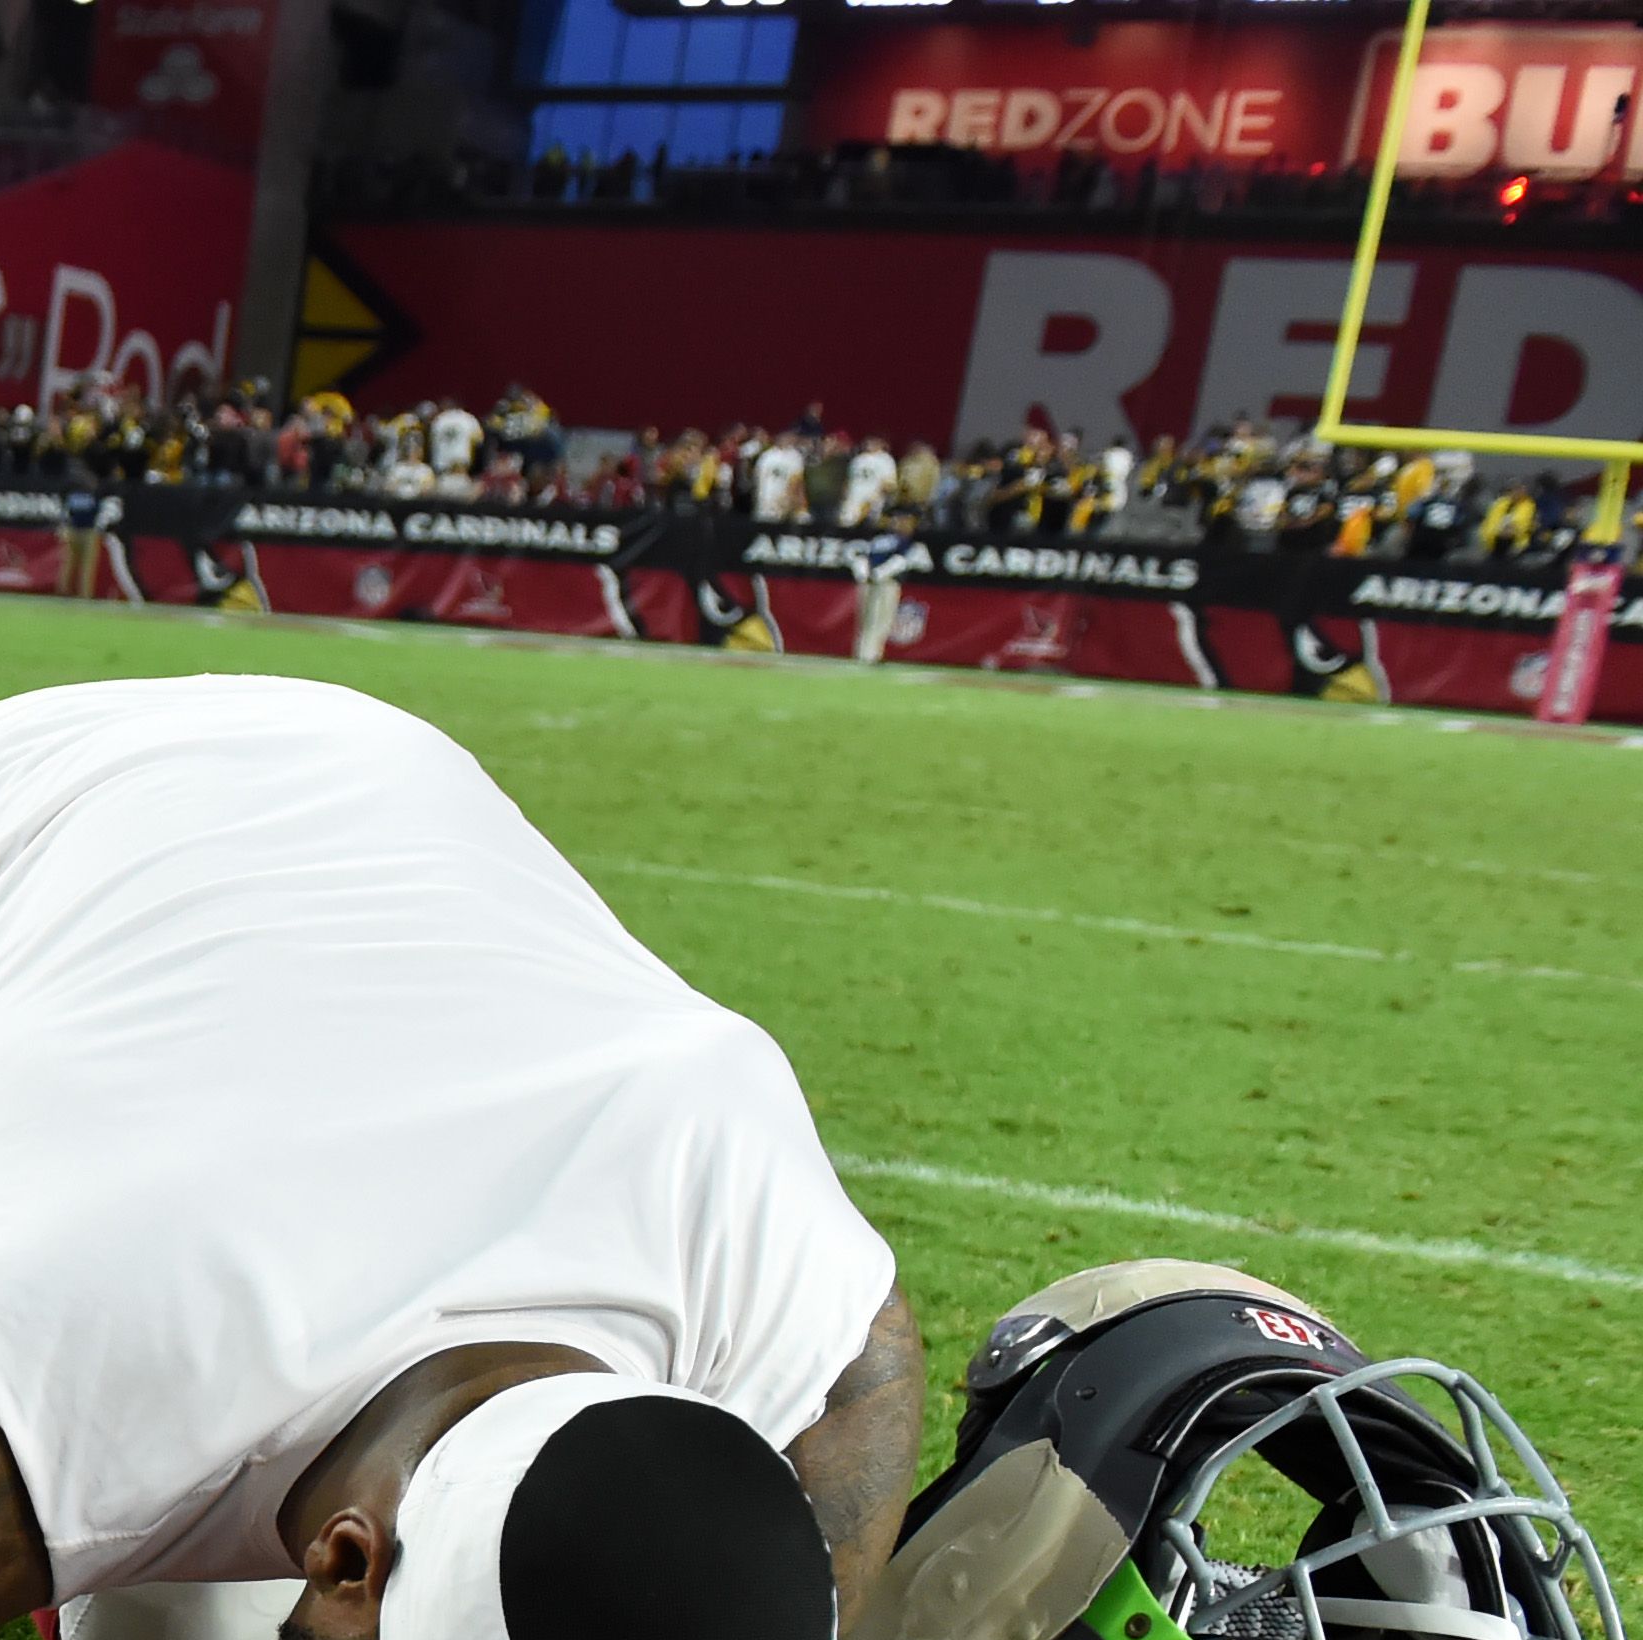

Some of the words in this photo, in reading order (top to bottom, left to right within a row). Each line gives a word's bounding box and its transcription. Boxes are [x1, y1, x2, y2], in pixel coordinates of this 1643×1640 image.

[886, 87, 1283, 157] REDZONE
[1400, 62, 1643, 182] BU
[234, 501, 398, 540] ARIZONA
[403, 510, 621, 556] CARDINALS
[943, 542, 1200, 591] CARDINALS
